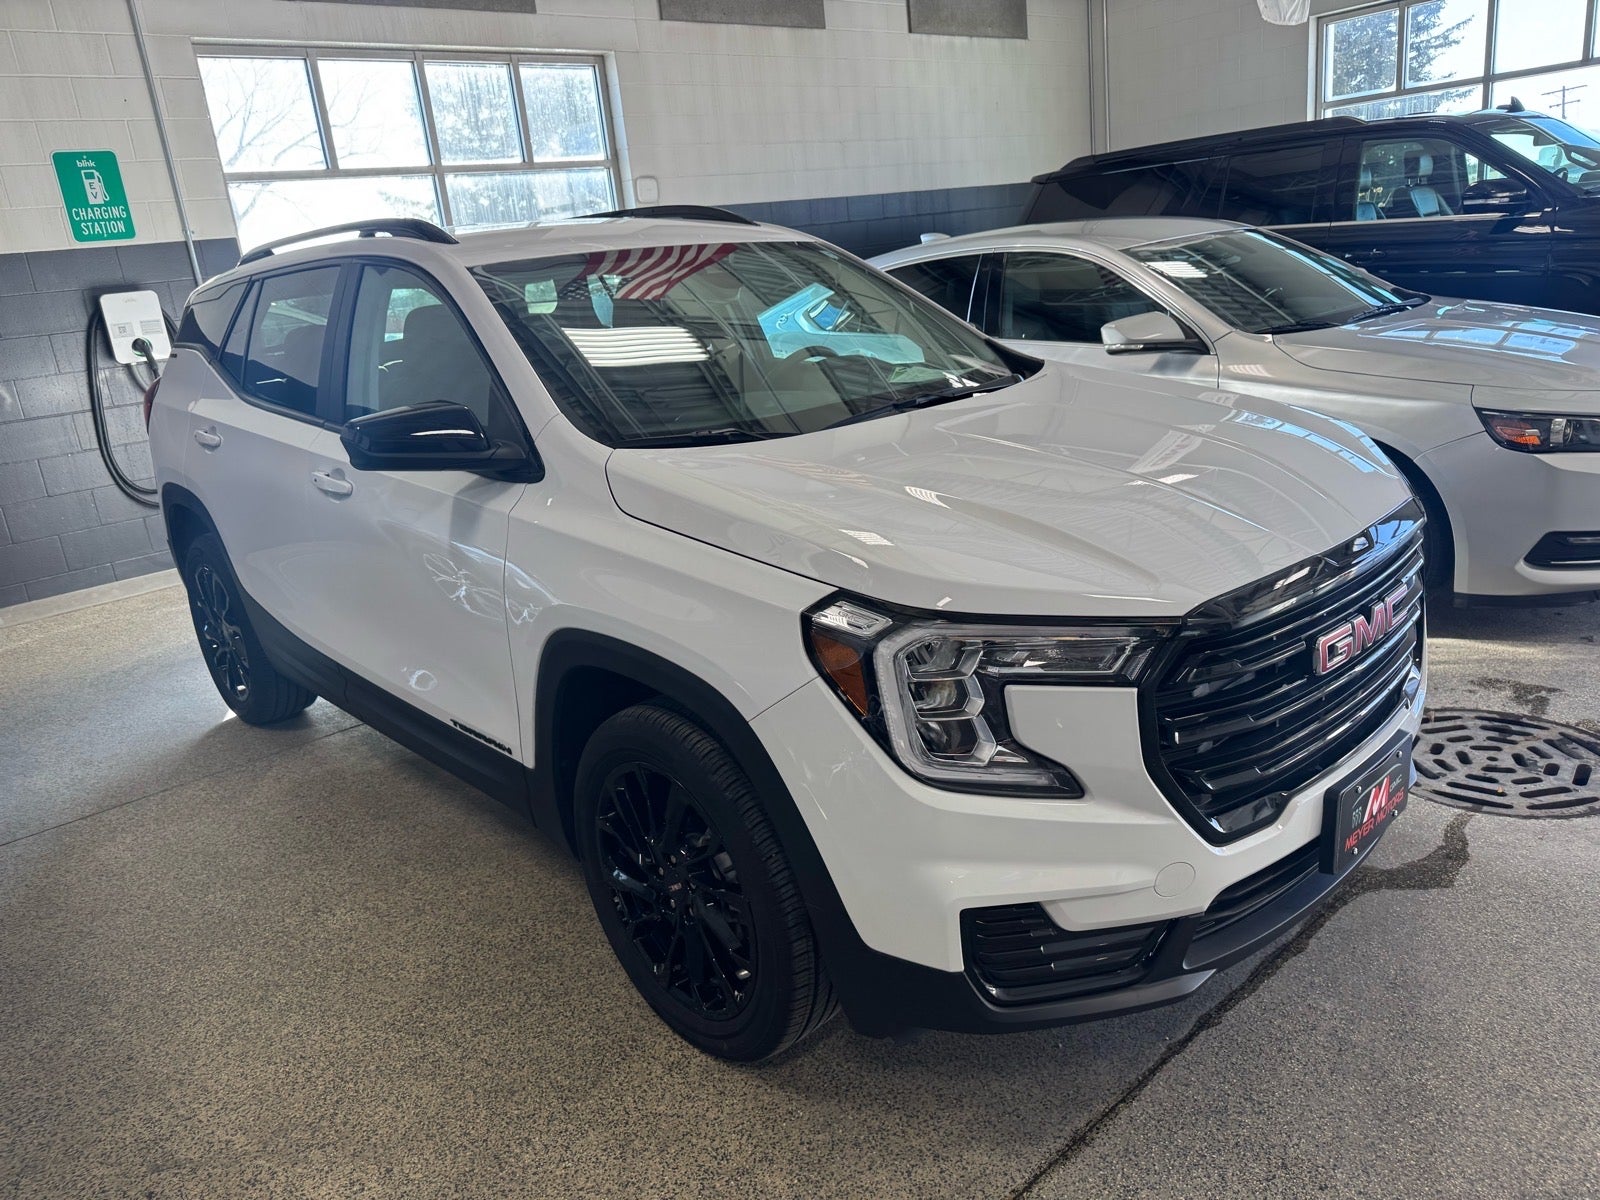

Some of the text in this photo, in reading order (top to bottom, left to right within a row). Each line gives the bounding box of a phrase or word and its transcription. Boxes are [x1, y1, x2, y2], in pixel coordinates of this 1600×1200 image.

[76, 160, 96, 168] blink
[72, 206, 127, 221] CHARGING
[81, 220, 126, 236] STATION
[1313, 584, 1408, 676] GMC
[1344, 786, 1405, 852] MEYER MOTORS
